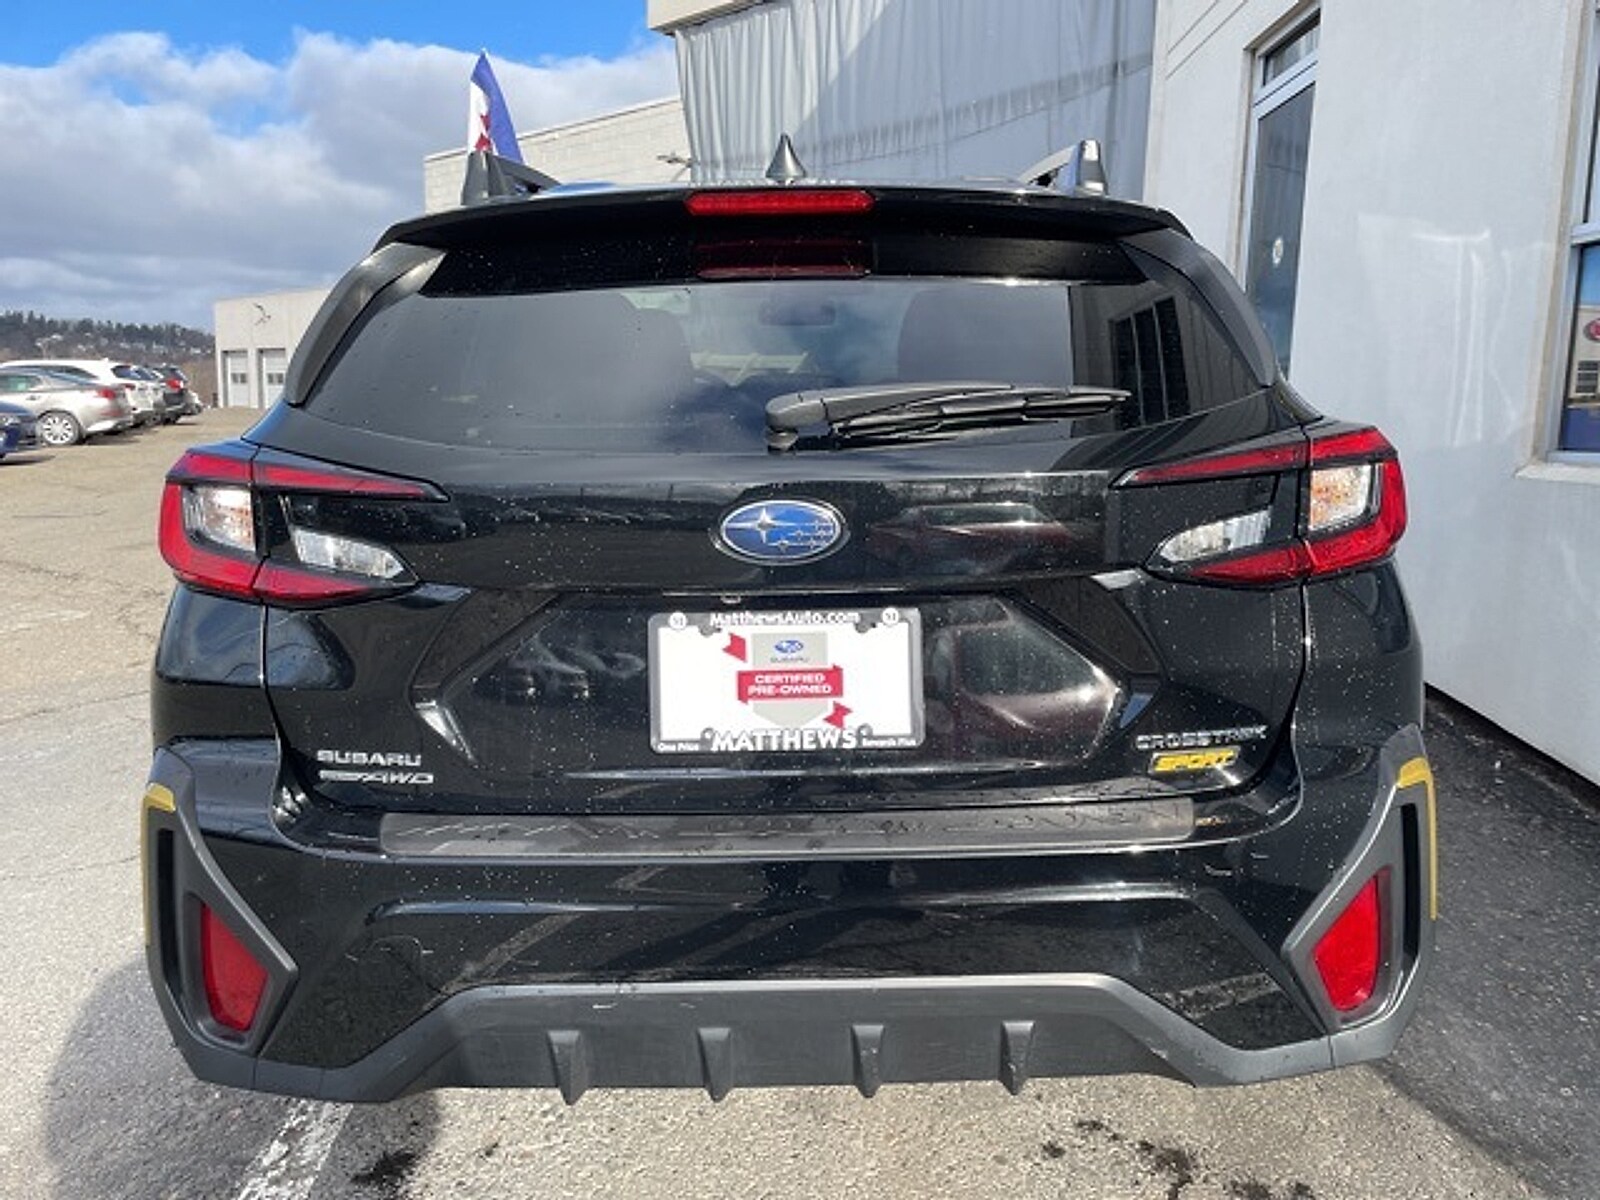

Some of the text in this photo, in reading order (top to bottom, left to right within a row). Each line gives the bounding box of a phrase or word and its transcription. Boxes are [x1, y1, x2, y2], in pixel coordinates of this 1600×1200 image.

[709, 610, 861, 627] MatthewsAuto.com
[755, 674, 826, 684] CERTIFIED
[747, 684, 832, 696] PRE-OWNED
[710, 728, 858, 751] MATTHEWS
[317, 750, 422, 766] SUBARU
[1154, 748, 1234, 772] SPORT
